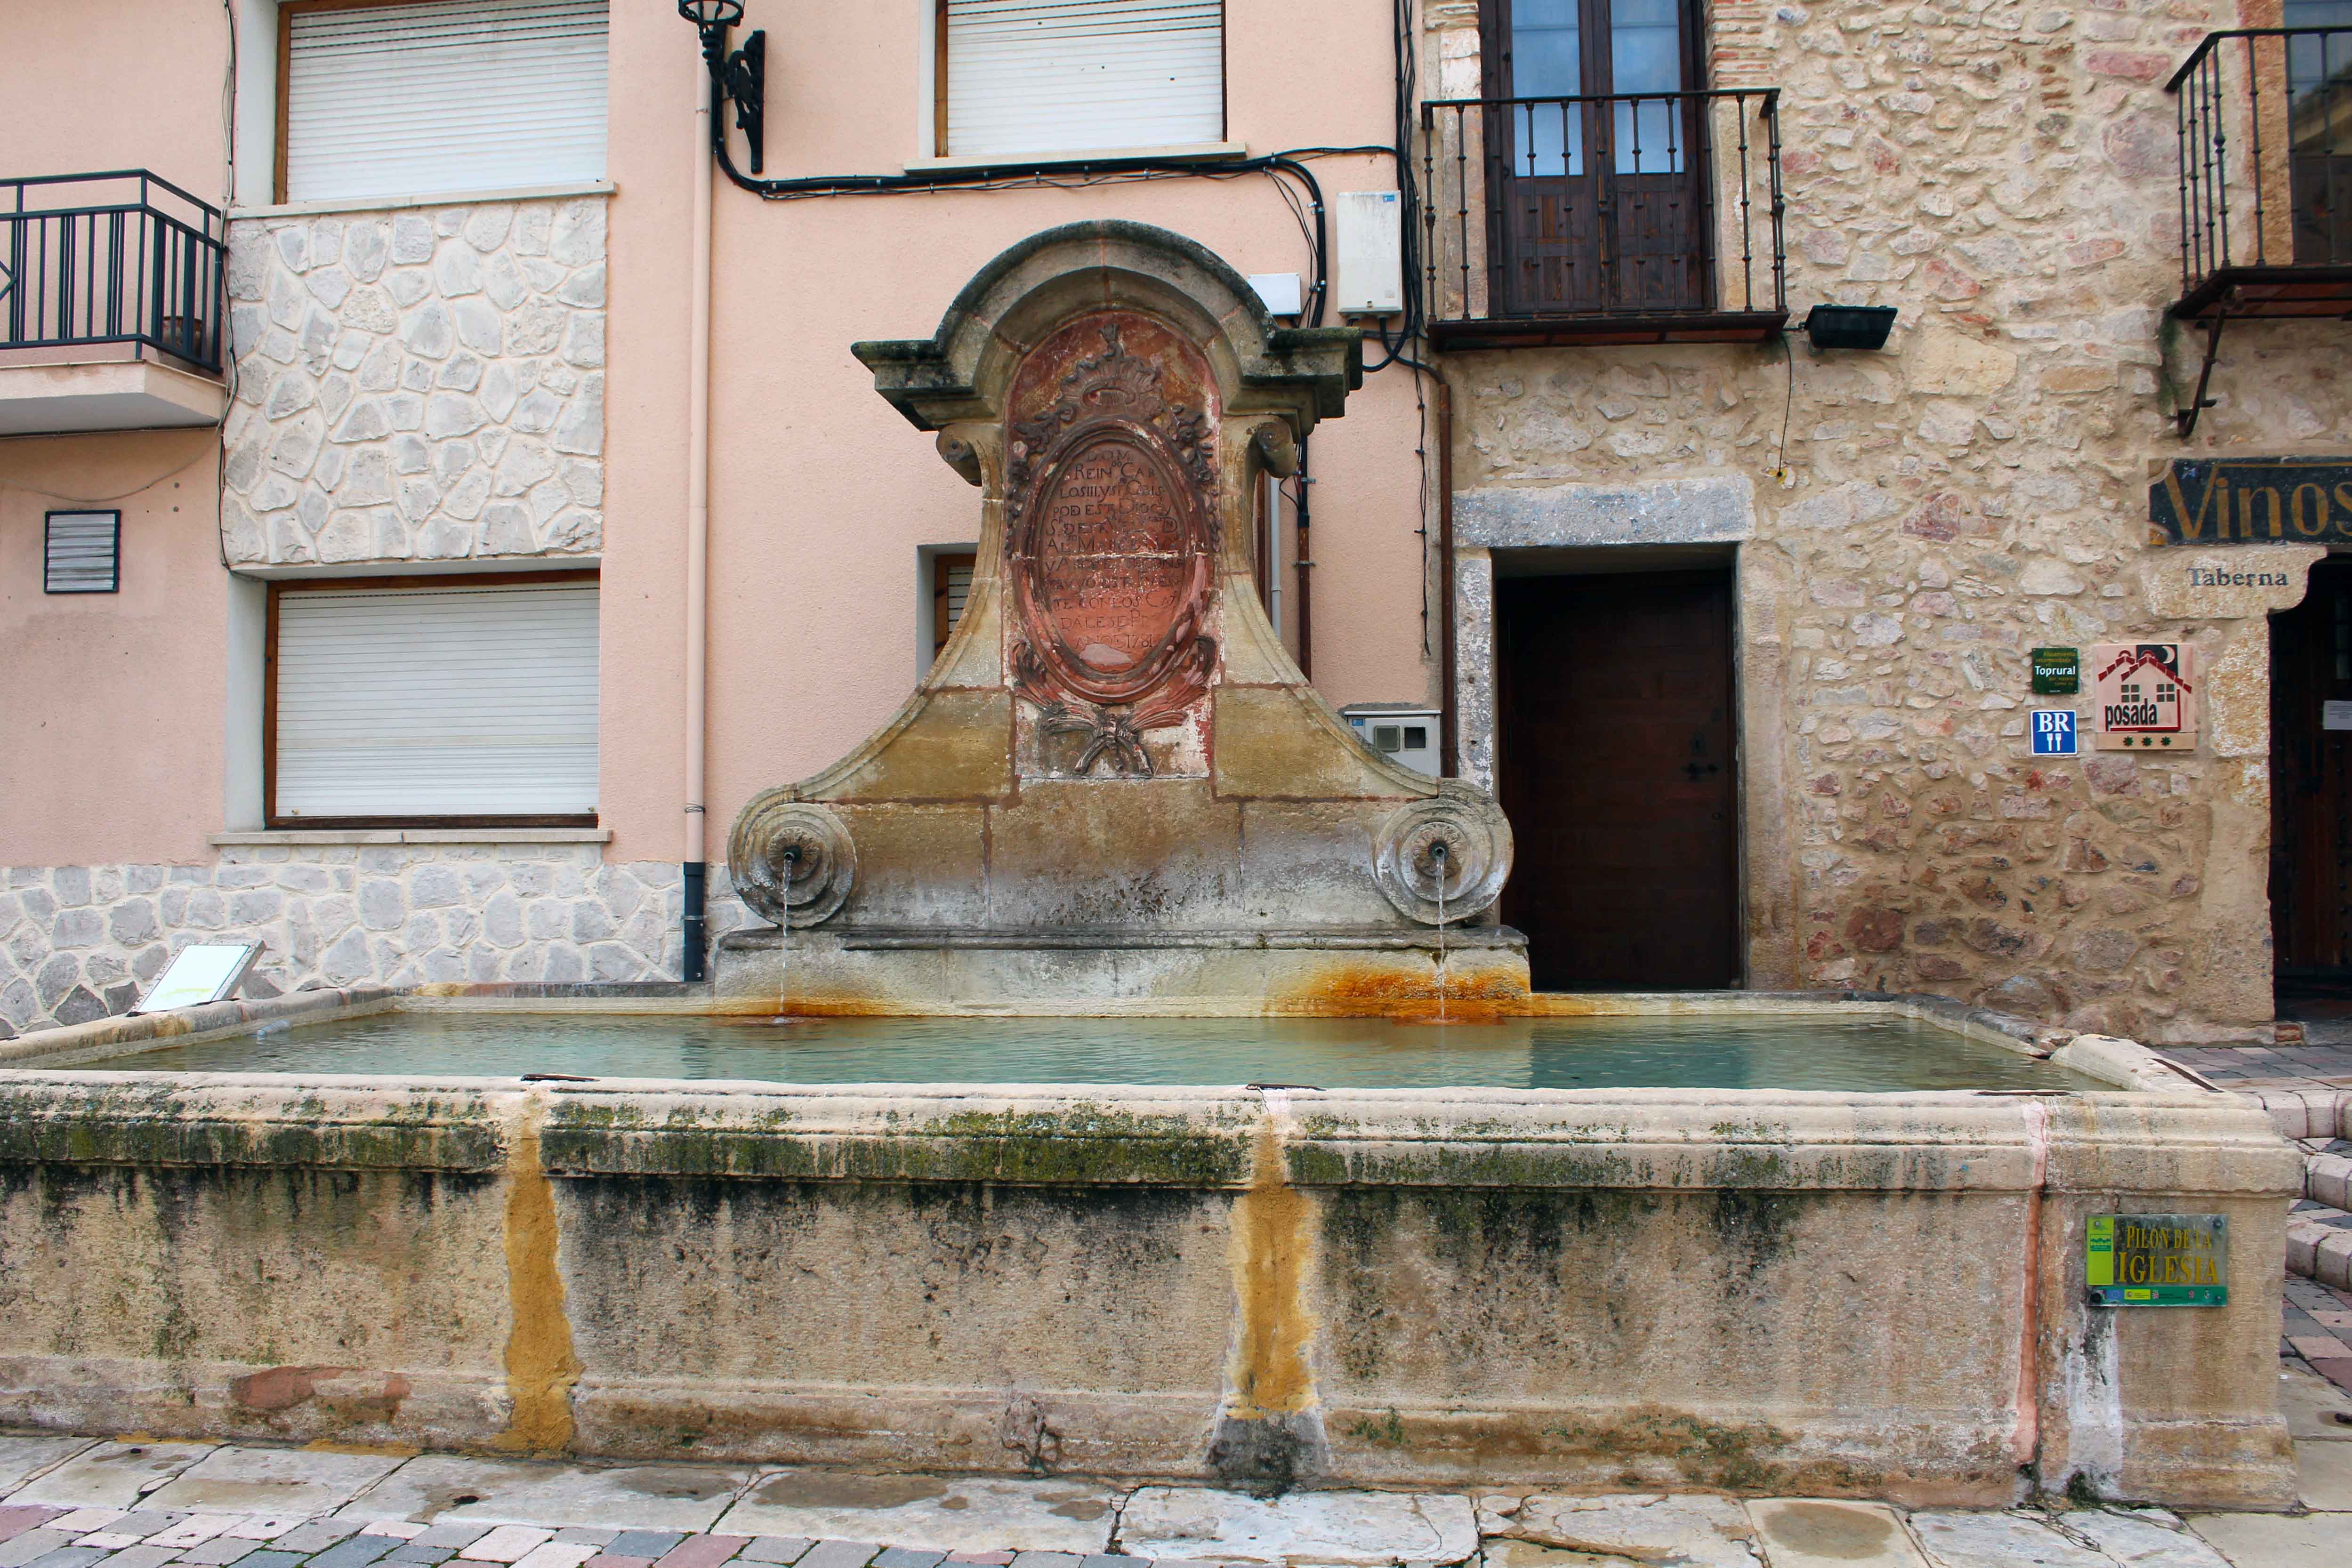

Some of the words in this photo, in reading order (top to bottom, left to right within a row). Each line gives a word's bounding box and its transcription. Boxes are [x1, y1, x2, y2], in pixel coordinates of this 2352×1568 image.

[2187, 567, 2288, 587] Taberna
[2035, 666, 2076, 677] Toprural
[2038, 713, 2070, 732] BR
[2105, 698, 2157, 731] posada
[2174, 1229, 2192, 1249] DE
[2118, 1252, 2219, 1285] IGLESIA
